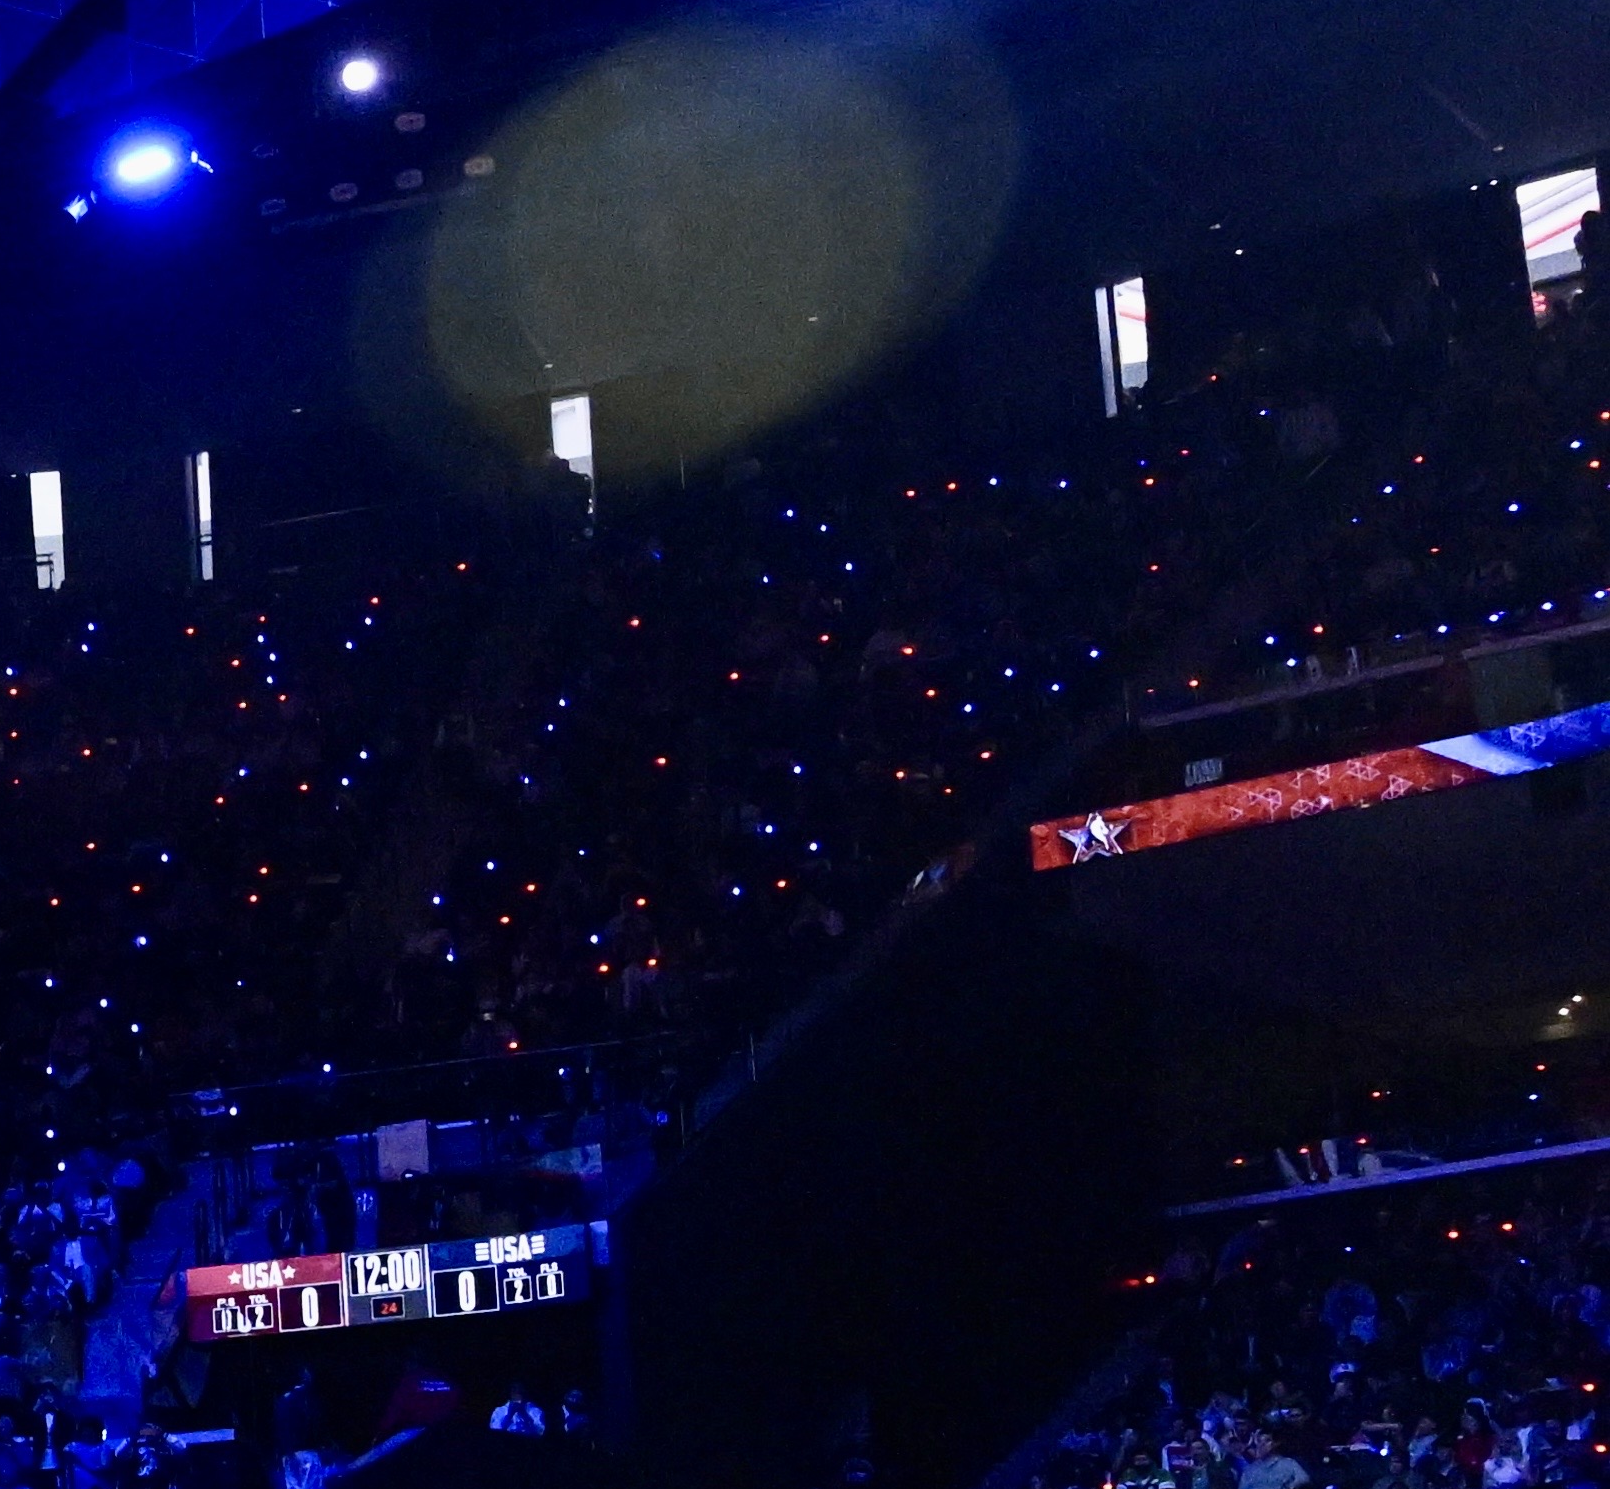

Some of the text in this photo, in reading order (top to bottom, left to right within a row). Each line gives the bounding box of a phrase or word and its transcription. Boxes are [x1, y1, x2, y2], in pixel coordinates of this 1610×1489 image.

[490, 1237, 532, 1264] USA
[242, 1262, 282, 1289] USA
[354, 1252, 420, 1294] 12:00
[459, 1271, 475, 1311] 0
[302, 1287, 319, 1327] 0
